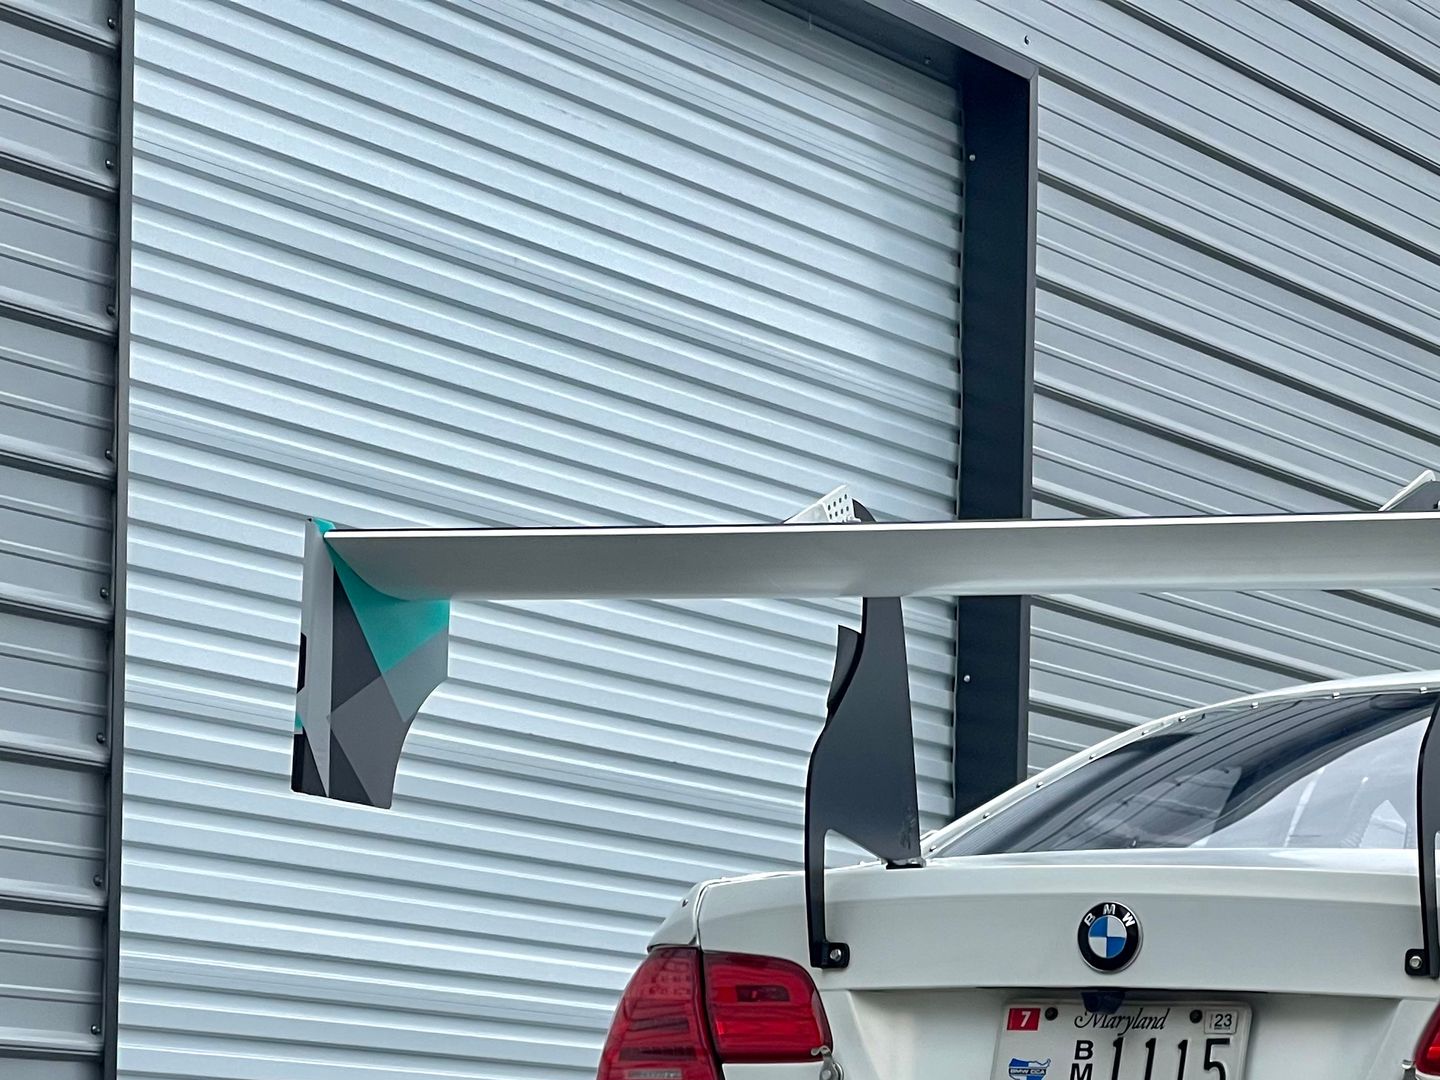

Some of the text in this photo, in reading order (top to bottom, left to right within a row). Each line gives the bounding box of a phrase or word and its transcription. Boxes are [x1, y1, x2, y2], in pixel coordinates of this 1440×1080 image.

[1084, 903, 1136, 927] BMW
[1020, 1010, 1032, 1028] 7
[1074, 1007, 1171, 1036] Maryland
[1214, 1013, 1232, 1027] 23
